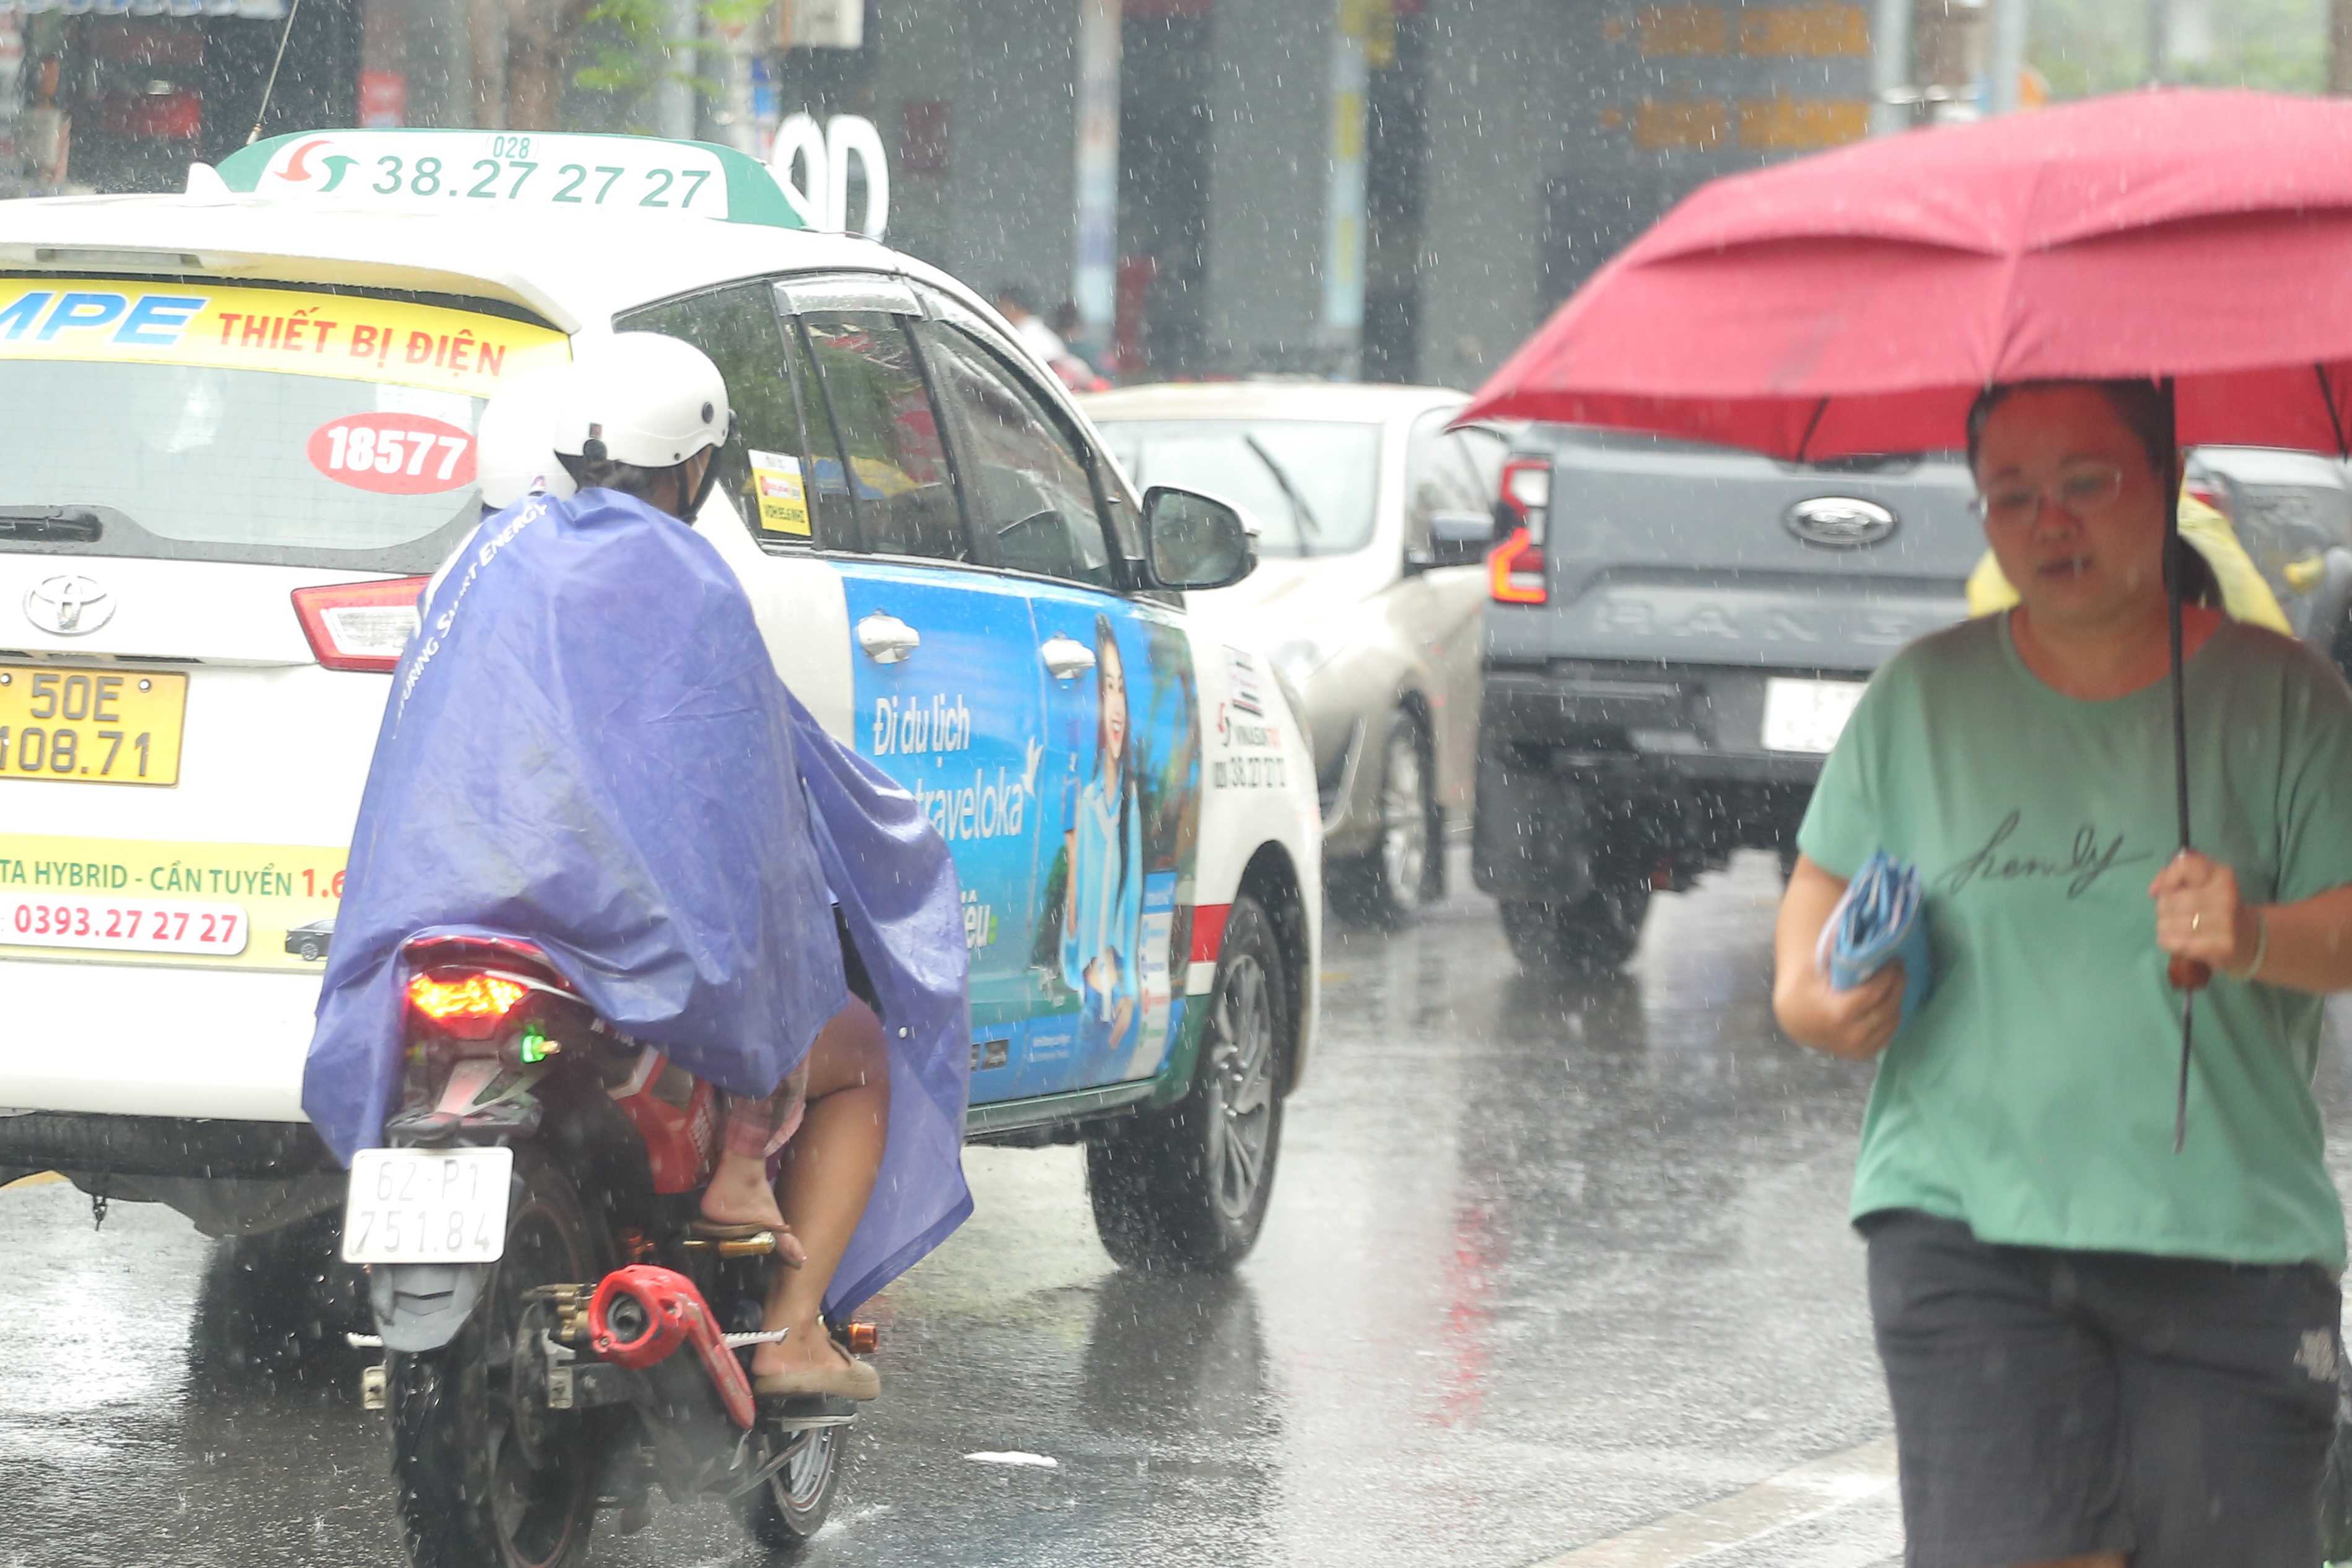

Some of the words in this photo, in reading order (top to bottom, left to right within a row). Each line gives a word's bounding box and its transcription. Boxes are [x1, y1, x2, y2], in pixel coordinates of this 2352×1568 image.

[372, 155, 539, 200] 38.27
[551, 163, 625, 205] 27
[639, 168, 712, 209] 27
[219, 307, 338, 353] THIẾT
[349, 324, 393, 368] BỊ
[406, 329, 507, 377] ĐIỆN
[328, 426, 468, 480] 18577
[479, 502, 548, 567] ENERGY
[31, 674, 123, 722] 50E
[0, 725, 151, 777] 108.71
[873, 695, 898, 756] Đi
[901, 696, 930, 755] du
[932, 693, 971, 768] lịch
[35, 861, 128, 889] HYBRID
[209, 863, 292, 896] TUYỂN
[15, 904, 142, 938] 0393.27
[152, 911, 190, 940] 27
[199, 913, 237, 943] 27
[377, 1159, 478, 1201] 62-P1
[356, 1211, 491, 1253] 751.84
